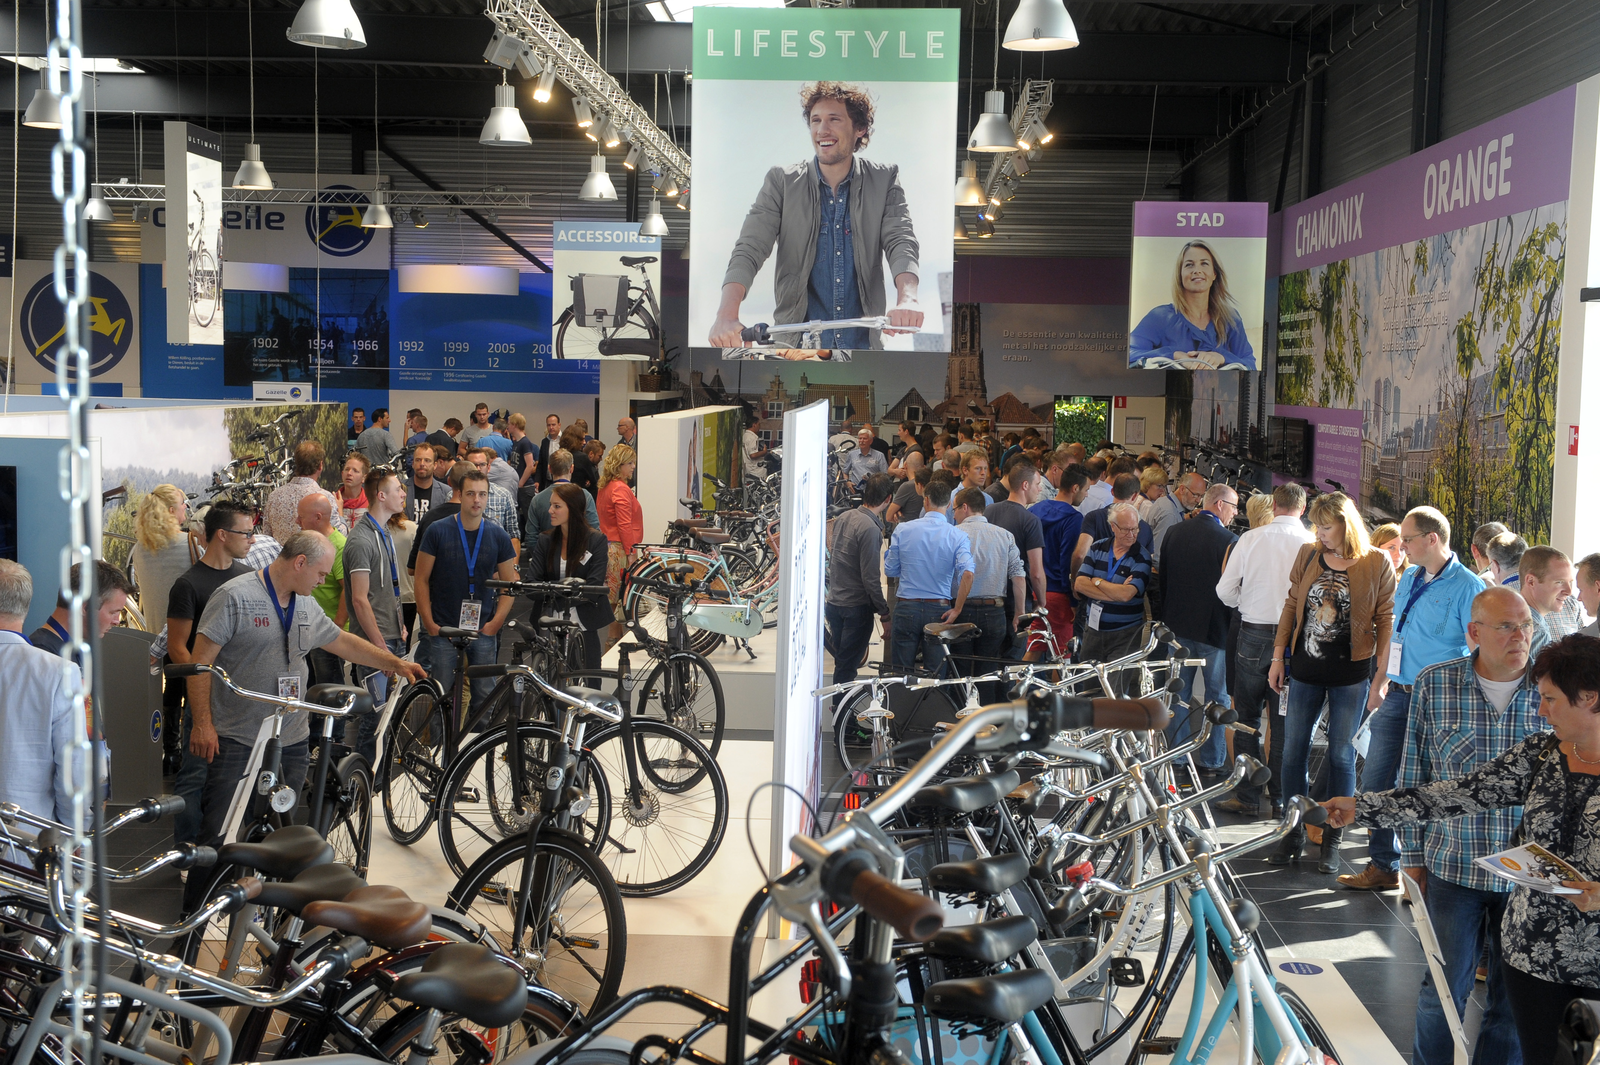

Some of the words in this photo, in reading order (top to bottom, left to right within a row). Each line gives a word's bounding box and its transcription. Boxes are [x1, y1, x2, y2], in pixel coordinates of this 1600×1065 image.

[706, 28, 945, 59] LIFESTYLE
[187, 135, 220, 152] ULTIMATE
[1422, 133, 1515, 220] ORANGE
[1176, 212, 1225, 228] STAD
[1294, 192, 1366, 258] CHAMONIX
[556, 229, 657, 244] ACCESSOIRES
[1002, 329, 1016, 339] De
[1017, 330, 1058, 339] essentie
[1060, 331, 1077, 340] van
[1078, 330, 1123, 340] kwaliteit:
[253, 338, 279, 349] 1902
[308, 339, 334, 350] 1954
[352, 340, 379, 351] 1966
[398, 341, 425, 352] 1992
[443, 342, 470, 353] 1999
[487, 343, 516, 354] 2005
[532, 343, 553, 354] 200
[1002, 341, 1021, 351] met
[1022, 342, 1032, 351] al
[1033, 342, 1049, 351] het
[1051, 342, 1115, 353] noodzakelijke
[352, 355, 359, 365] 2
[399, 355, 407, 366] 8
[443, 356, 456, 367] 10
[488, 357, 500, 368] 12
[532, 358, 544, 369] 13
[1002, 354, 1032, 362] eraan.
[577, 360, 589, 370] 14
[254, 616, 270, 628] 96
